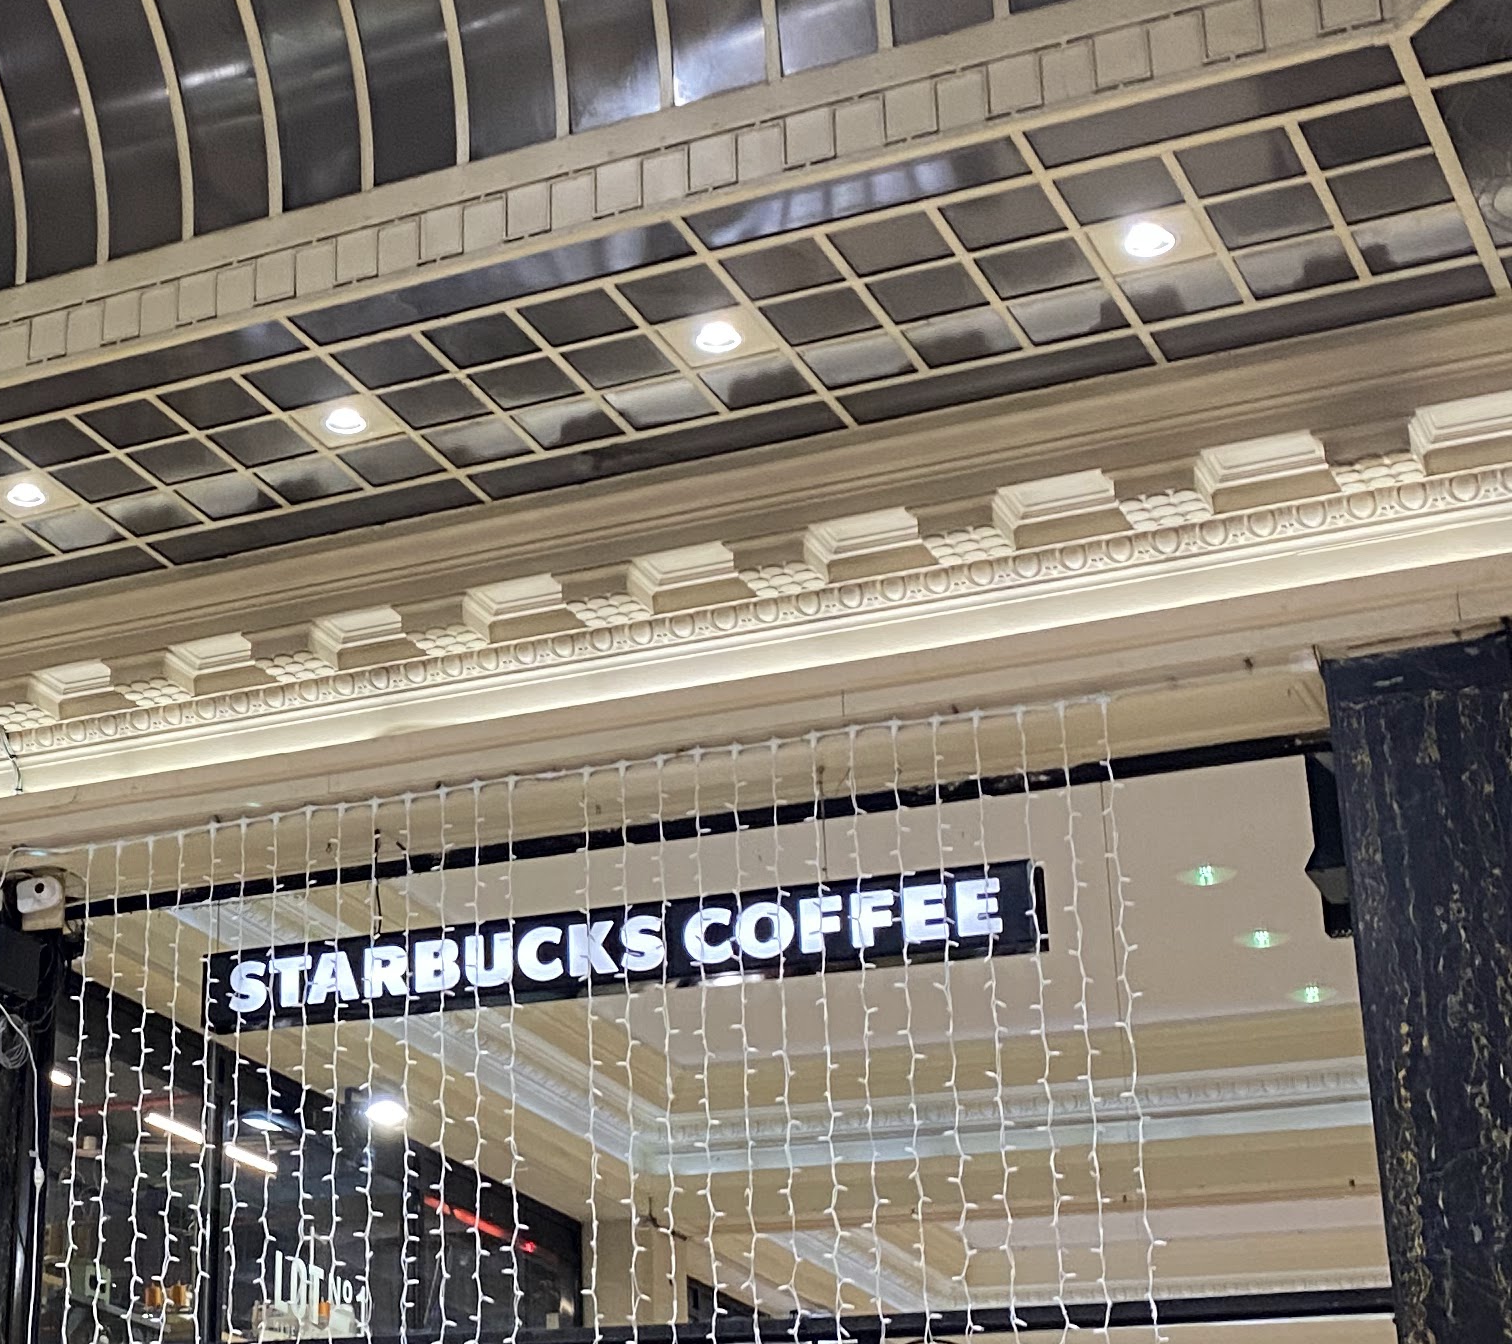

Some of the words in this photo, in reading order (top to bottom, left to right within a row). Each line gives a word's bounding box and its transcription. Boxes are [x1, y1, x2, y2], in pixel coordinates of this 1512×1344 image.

[228, 912, 665, 1014] STARBUCKS
[684, 876, 1004, 965] COFFEE
[274, 1250, 325, 1326] LOT
